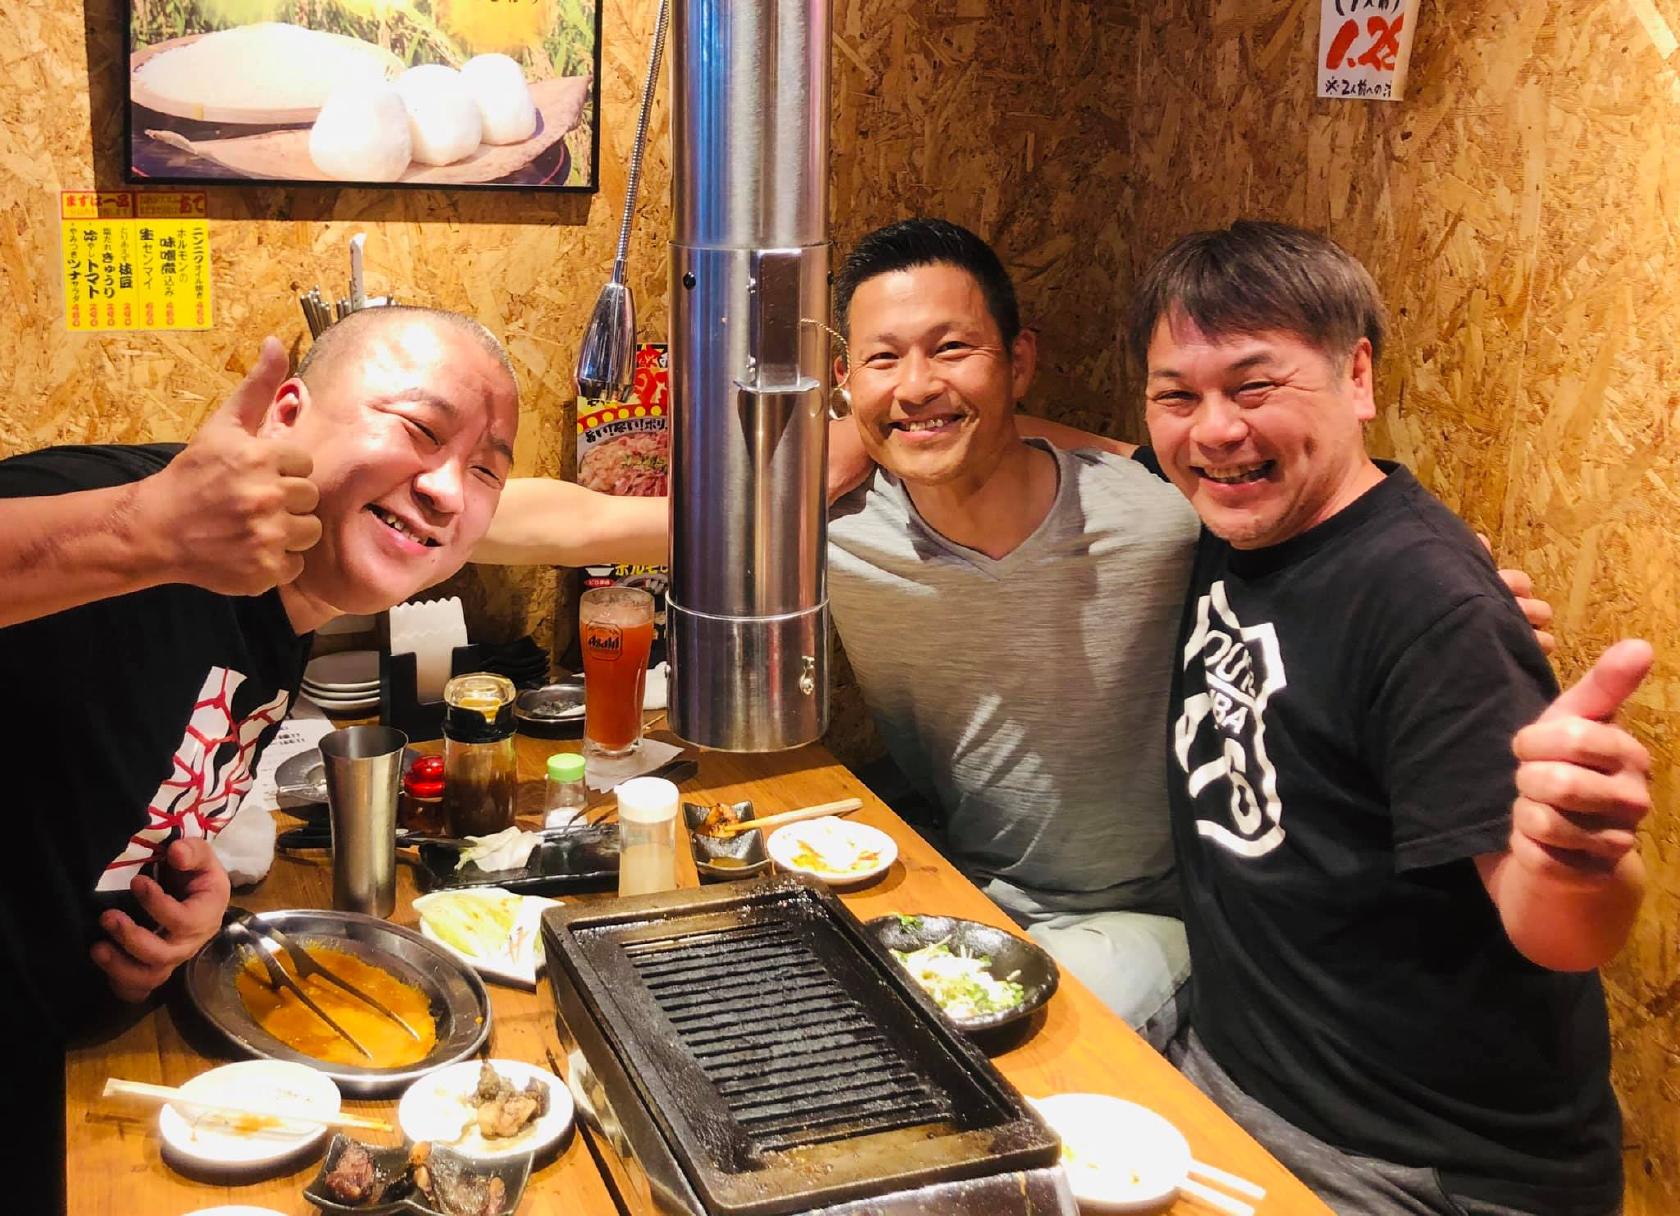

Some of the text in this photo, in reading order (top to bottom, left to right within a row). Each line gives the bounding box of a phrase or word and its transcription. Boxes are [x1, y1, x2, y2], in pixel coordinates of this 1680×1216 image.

[83, 229, 100, 299] 冷やしトマト
[588, 634, 620, 650] Asahi
